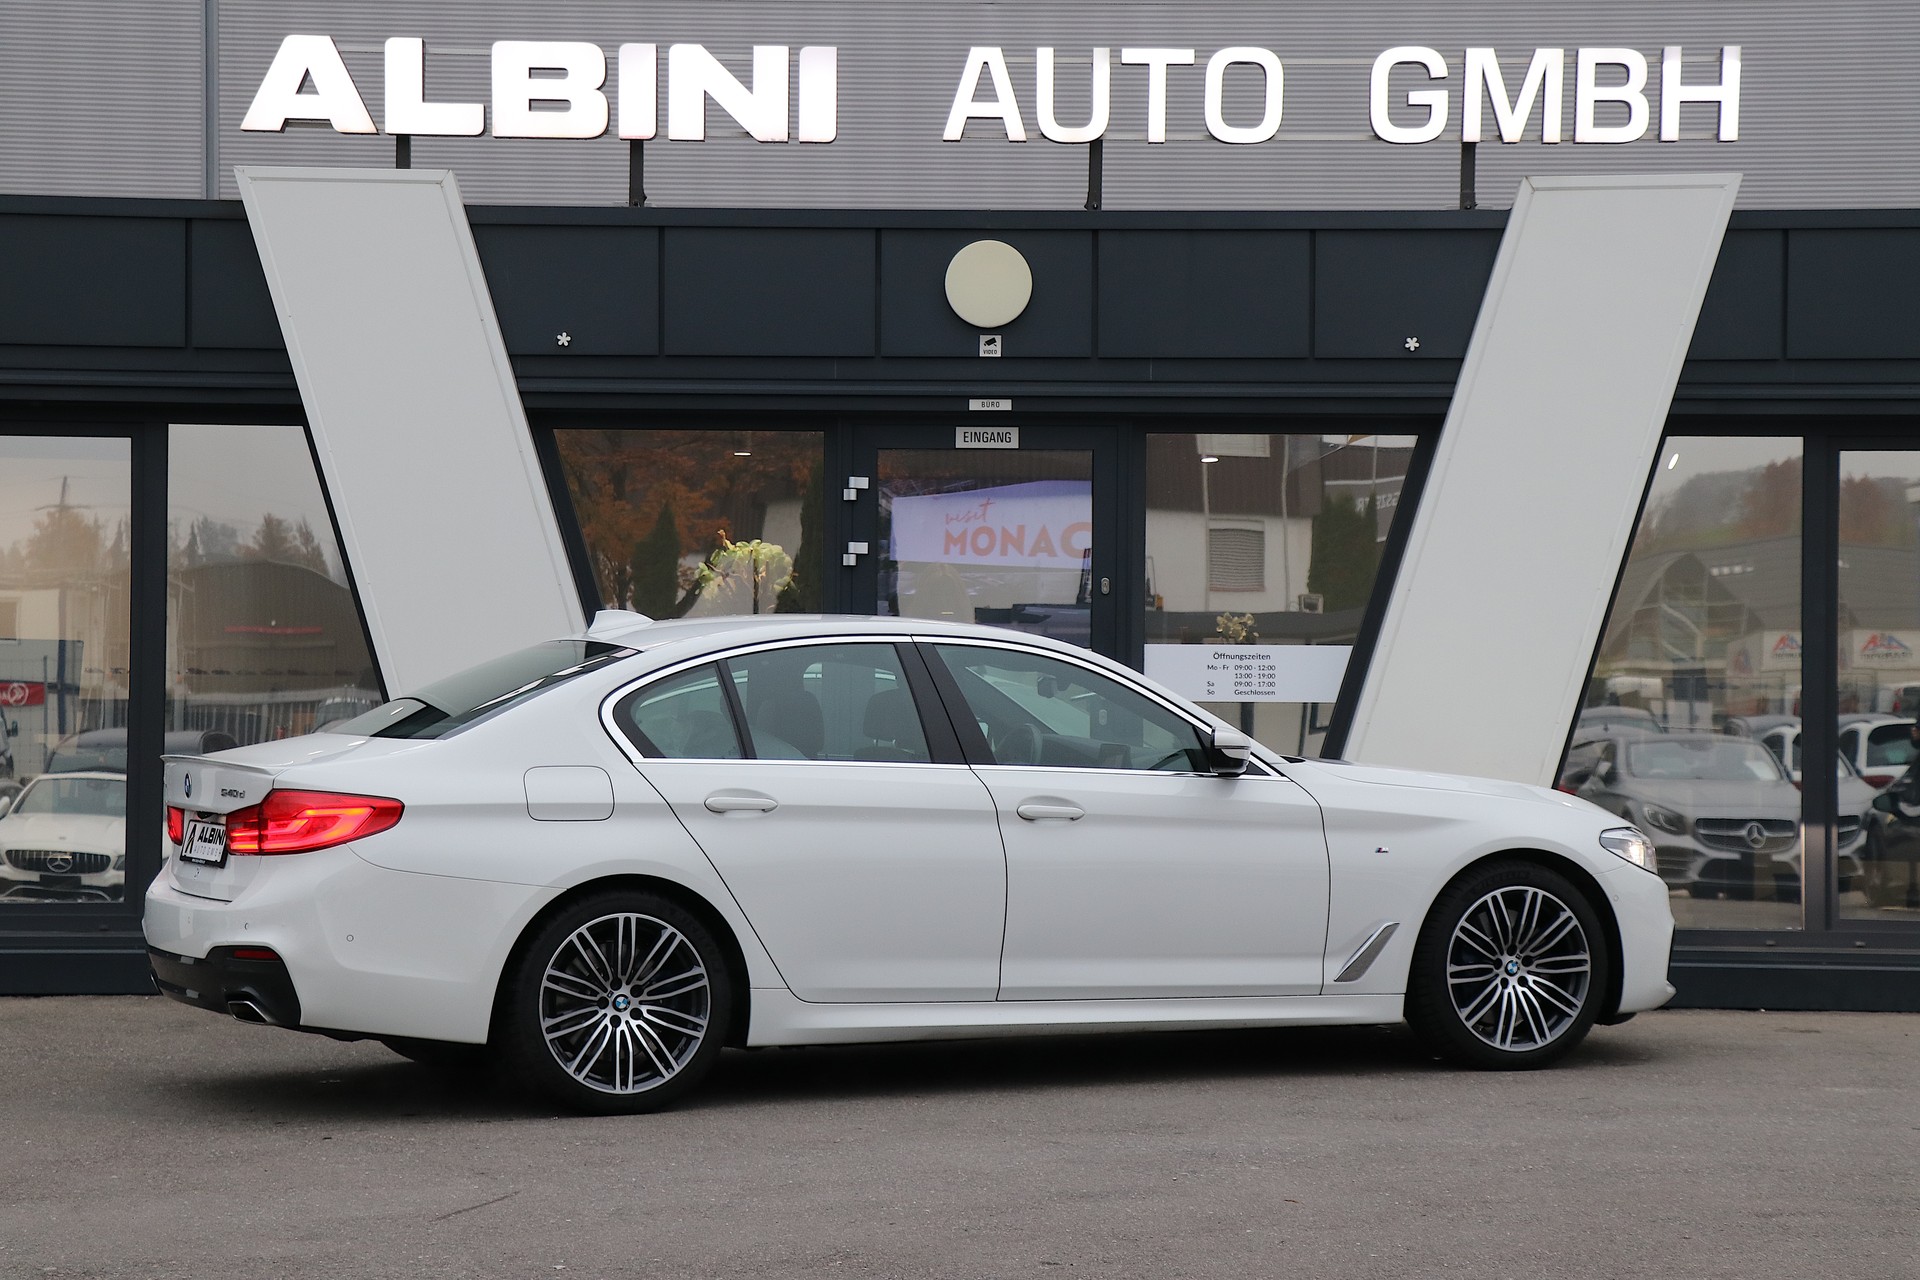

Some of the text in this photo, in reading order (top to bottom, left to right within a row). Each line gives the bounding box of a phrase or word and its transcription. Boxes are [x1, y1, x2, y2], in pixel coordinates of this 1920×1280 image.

[241, 34, 1742, 144] ALBINI AUTO GMBH
[981, 400, 1000, 408] BÜRO
[963, 431, 1012, 443] EINGANG
[943, 521, 1092, 559] MONAC
[1213, 651, 1271, 661] Öffnungszeiten
[197, 826, 226, 846] ALBINI
